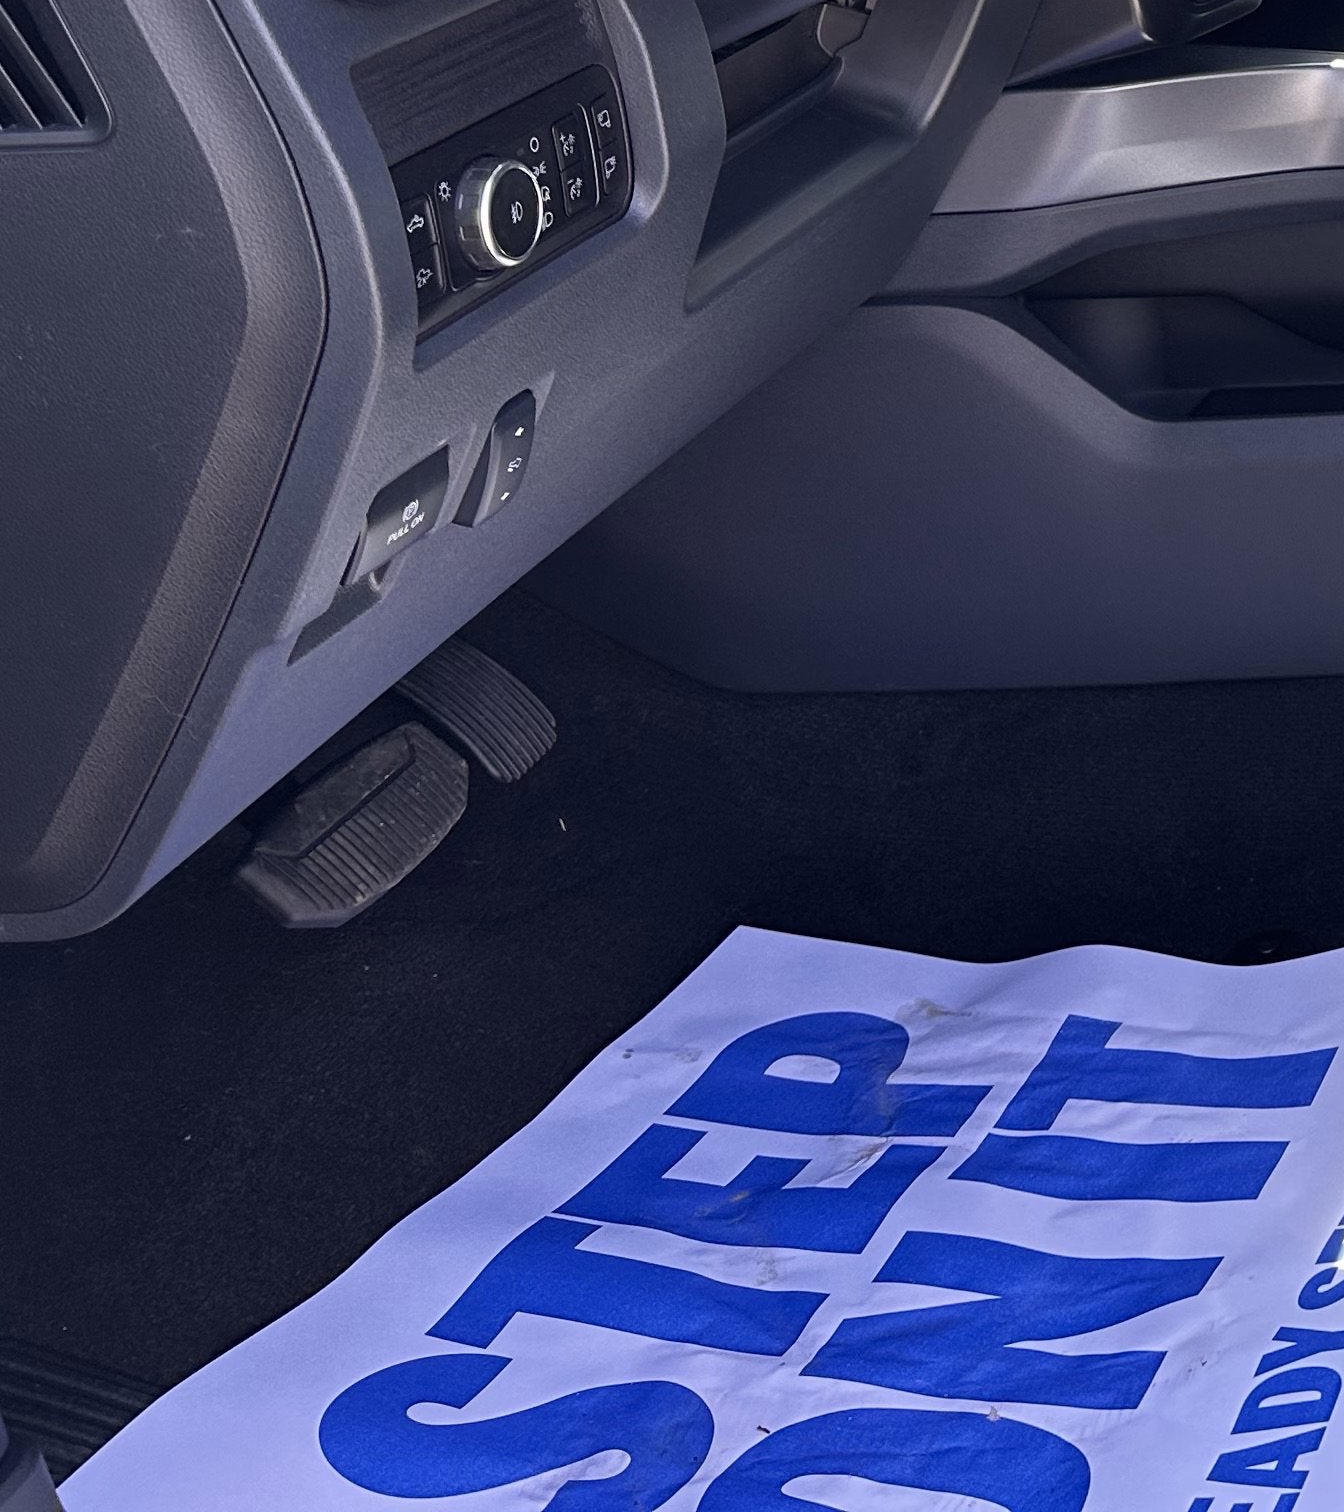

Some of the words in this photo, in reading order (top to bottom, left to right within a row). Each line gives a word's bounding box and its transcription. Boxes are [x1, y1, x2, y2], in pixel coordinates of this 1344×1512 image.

[386, 523, 410, 546] PULL
[410, 511, 425, 529] ON
[948, 1014, 1338, 1202] IT
[319, 1010, 993, 1512] STEP
[697, 1230, 1223, 1512] ON
